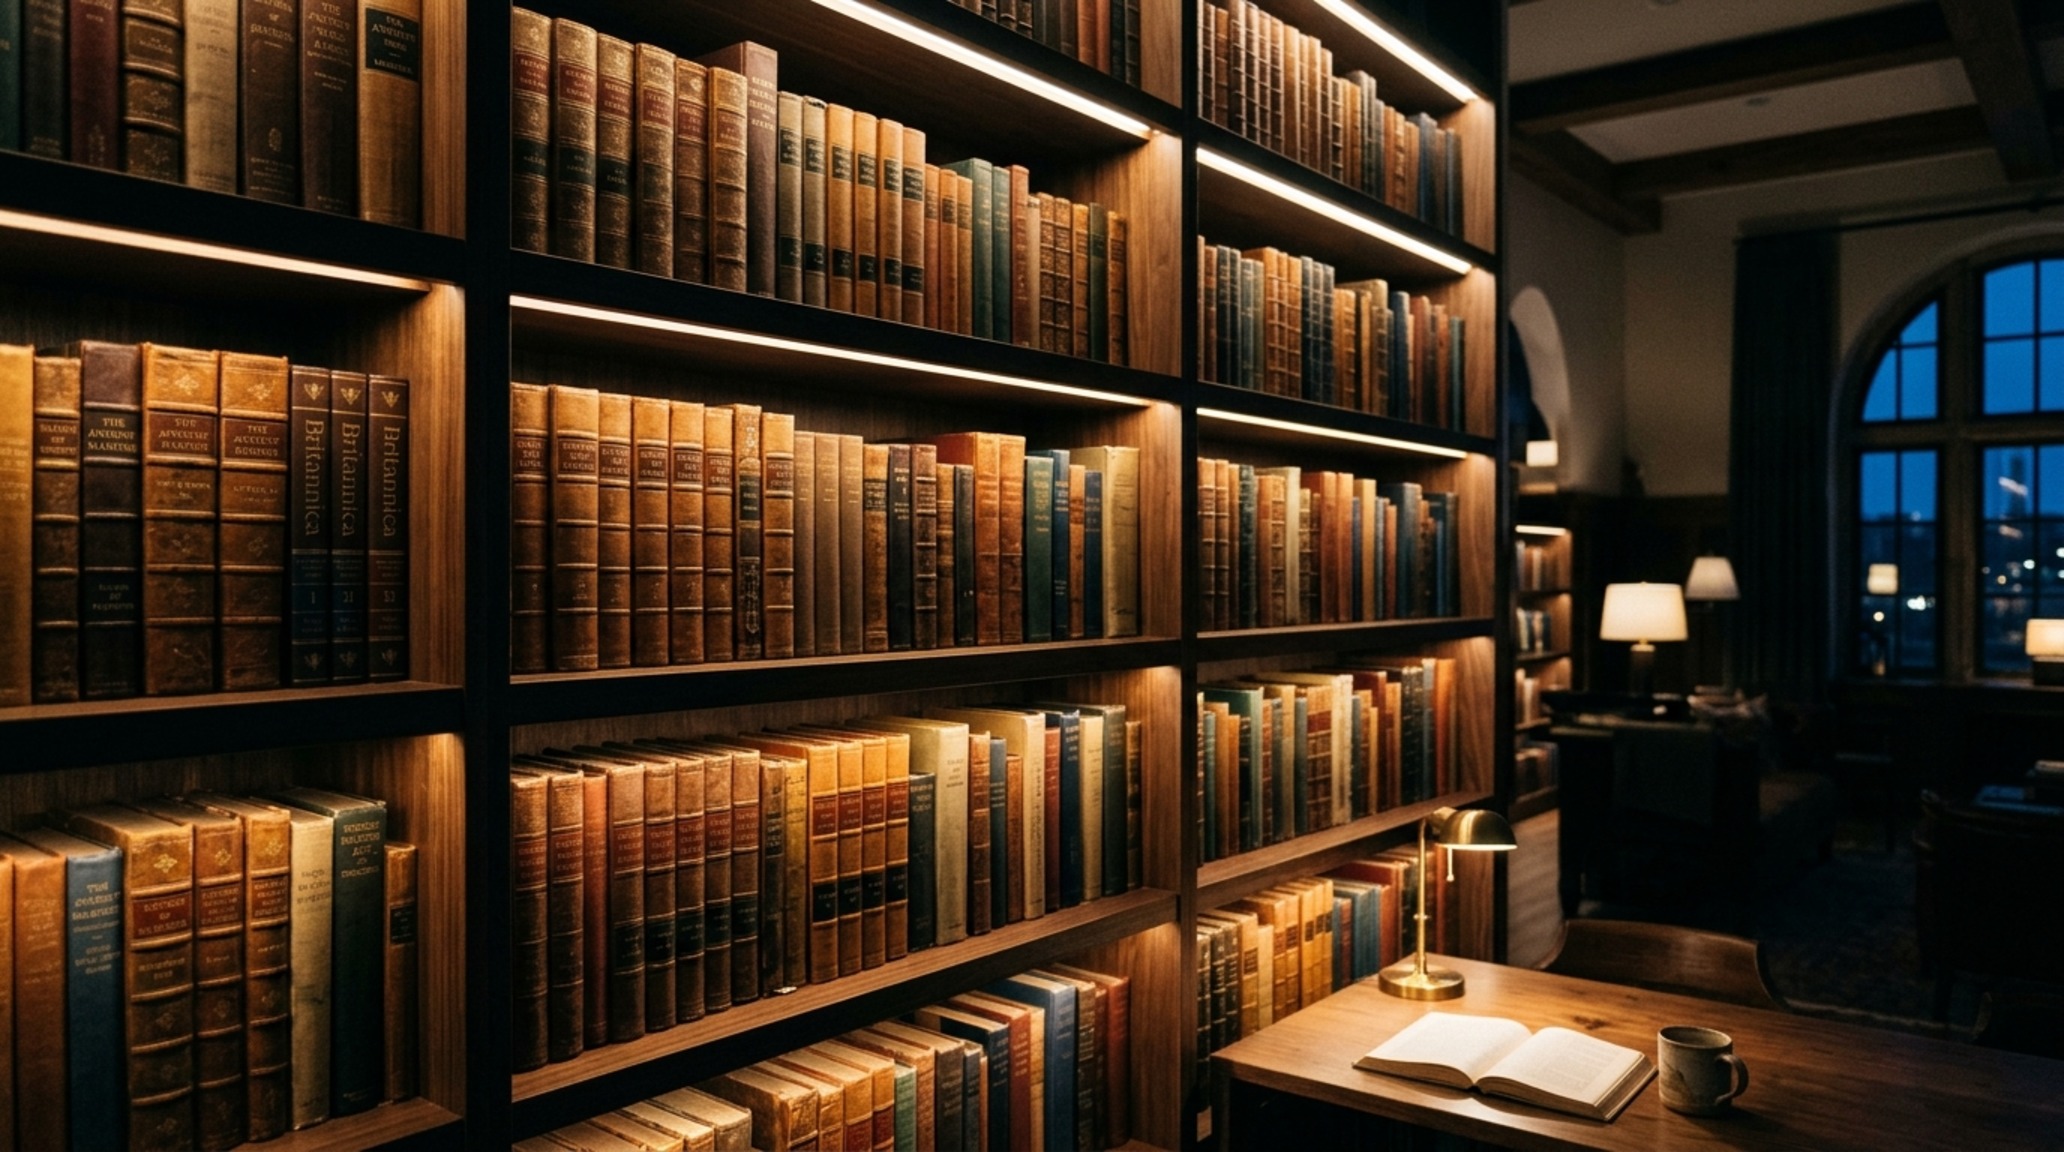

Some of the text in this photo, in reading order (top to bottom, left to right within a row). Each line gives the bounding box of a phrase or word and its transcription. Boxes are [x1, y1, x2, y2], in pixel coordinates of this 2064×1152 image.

[305, 419, 325, 536] Britannica
[342, 422, 362, 536] Britannica
[383, 426, 401, 537] Britannica
